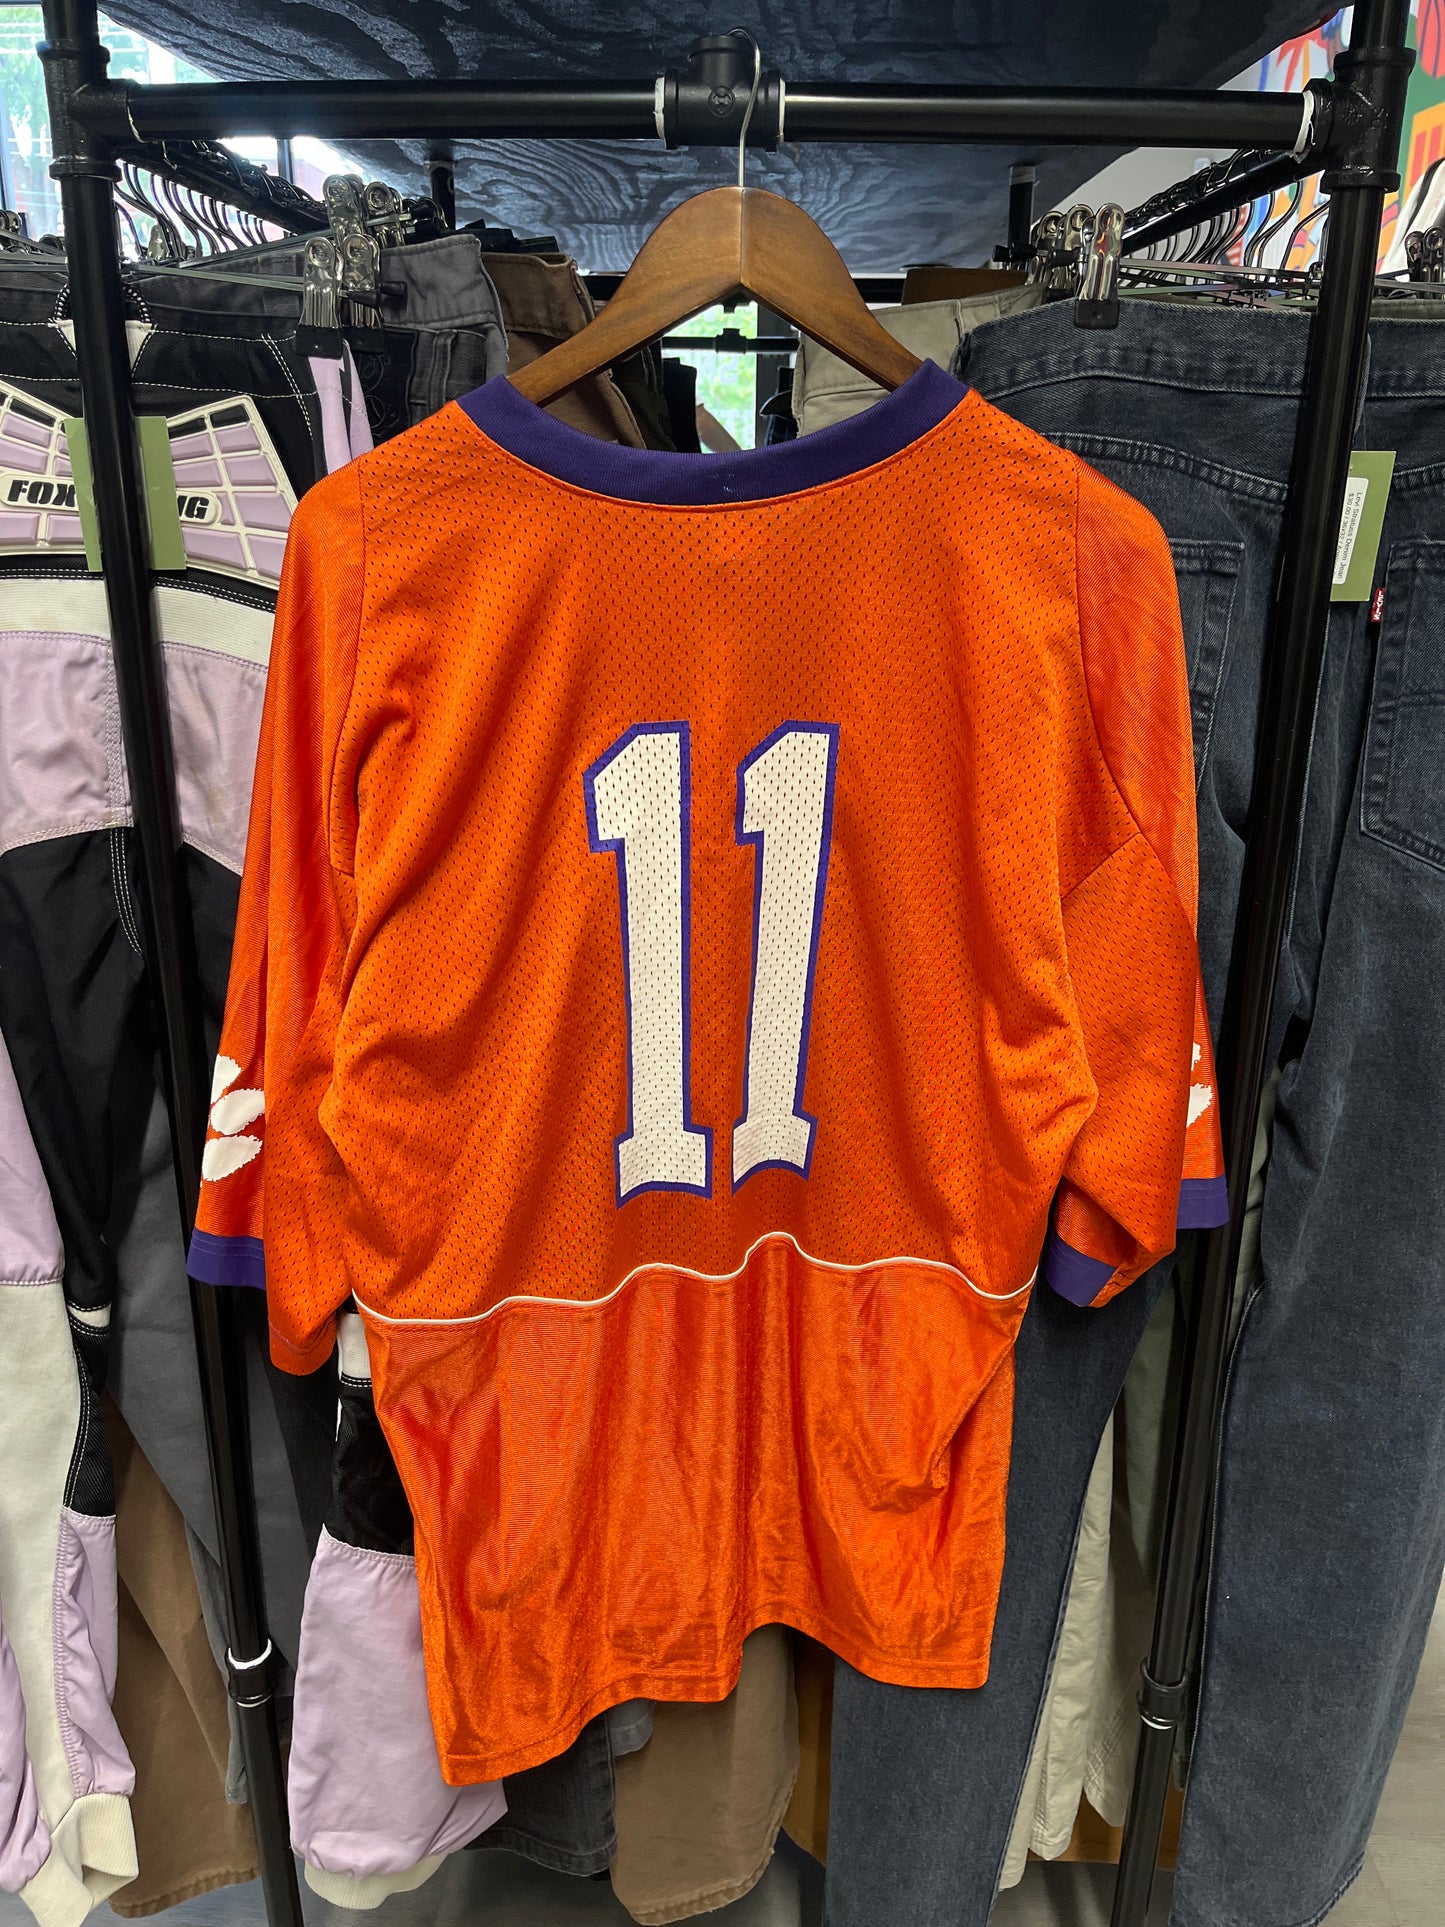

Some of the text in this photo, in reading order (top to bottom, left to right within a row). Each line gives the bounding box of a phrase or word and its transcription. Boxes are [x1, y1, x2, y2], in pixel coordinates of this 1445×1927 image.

[1354, 492, 1363, 507] Levi
[1343, 538, 1353, 561] Denim
[1337, 562, 1347, 579] Jean
[582, 719, 841, 1210] 11
